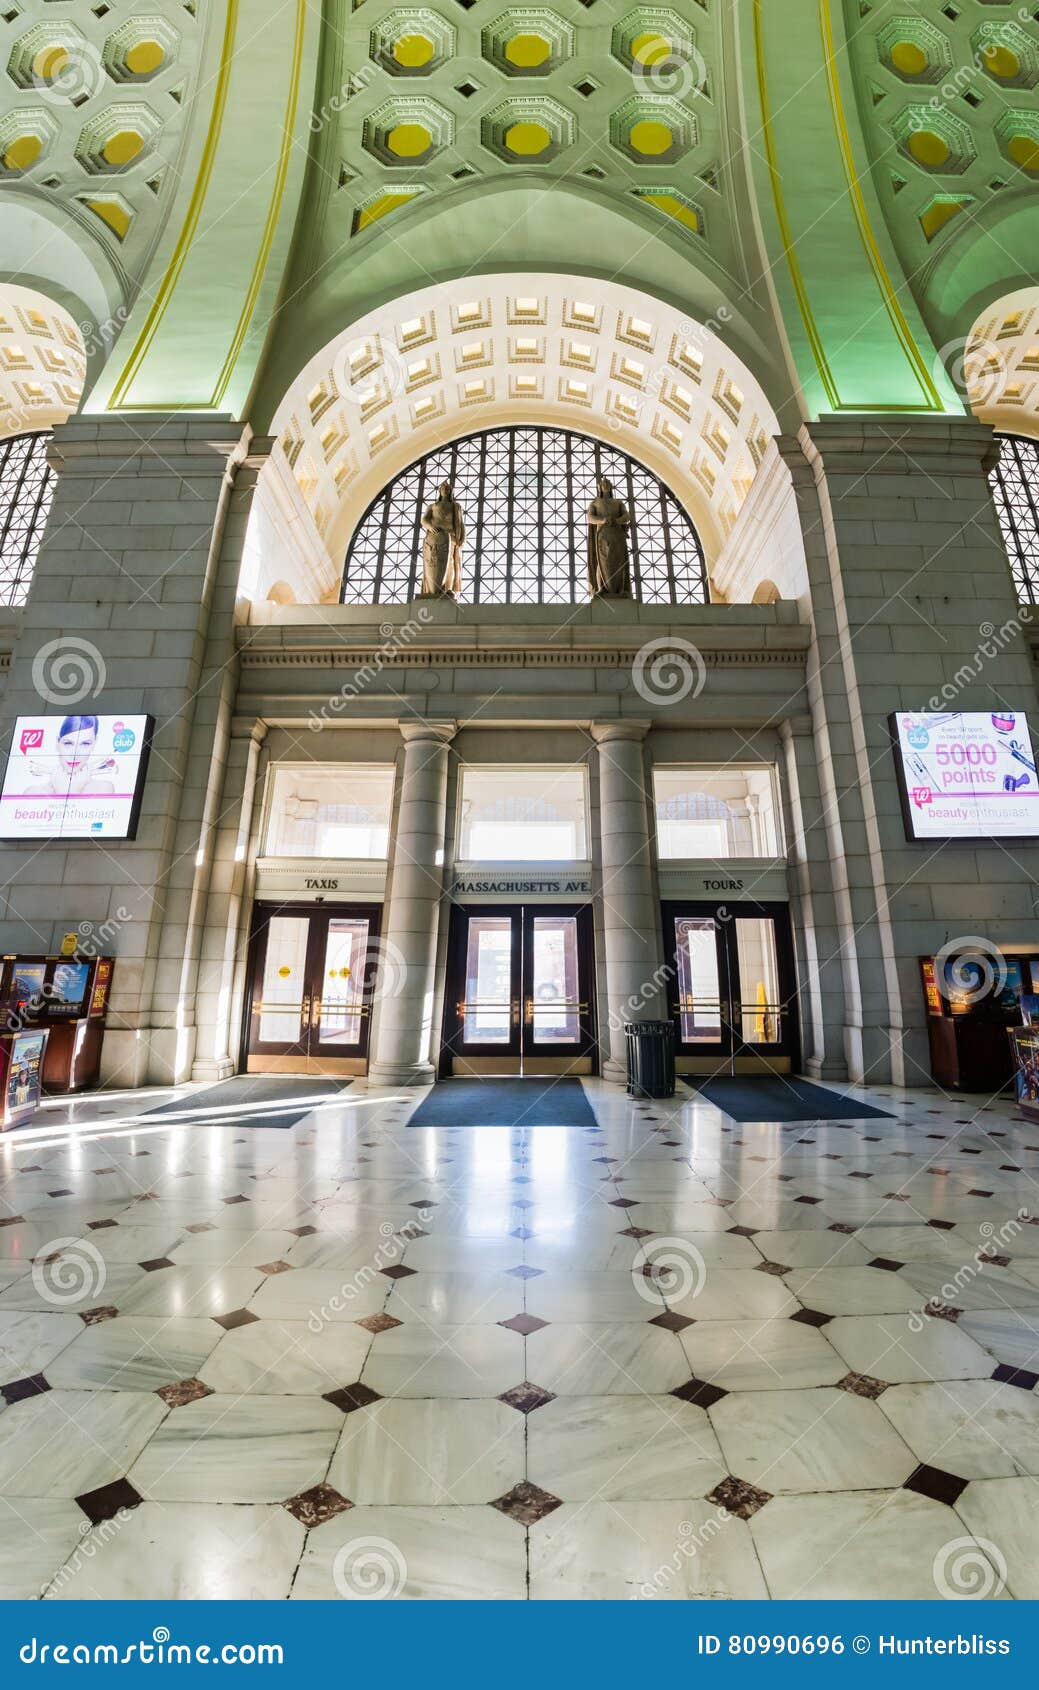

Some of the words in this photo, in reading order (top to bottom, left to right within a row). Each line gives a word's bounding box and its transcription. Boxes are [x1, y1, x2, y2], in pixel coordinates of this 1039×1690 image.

[935, 743, 997, 766] 5000
[942, 767, 997, 788] points
[304, 879, 339, 890] TAXIS
[454, 881, 560, 892] MASSACHUSETTS
[565, 881, 591, 892] AVE.
[703, 879, 744, 890] TOURS
